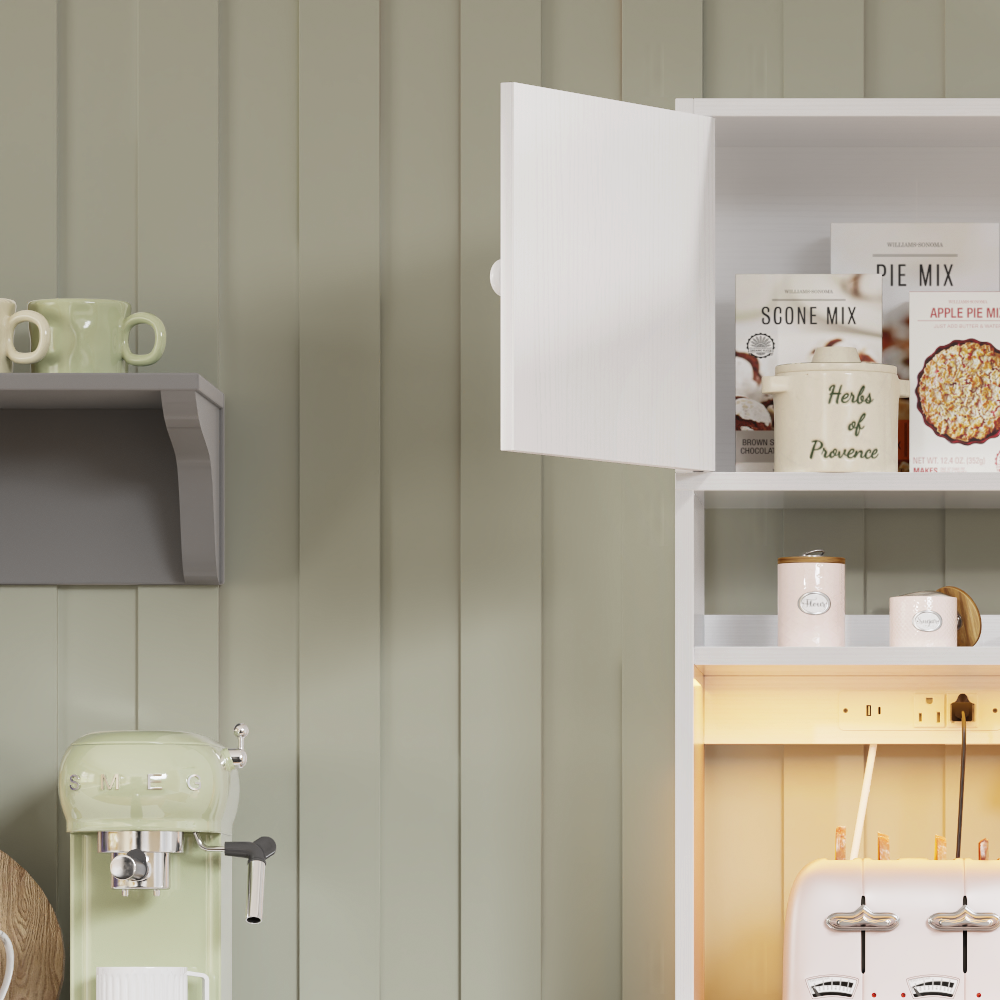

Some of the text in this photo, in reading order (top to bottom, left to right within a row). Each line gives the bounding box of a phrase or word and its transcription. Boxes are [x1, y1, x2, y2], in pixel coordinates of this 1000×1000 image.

[876, 264, 953, 287] PIE MIX
[761, 306, 857, 325] SCONE MIX
[930, 307, 963, 318] APPLE
[967, 307, 983, 318] PIE
[827, 384, 874, 404] Herbs
[847, 412, 867, 437] of
[809, 439, 879, 459] Provence
[69, 773, 202, 791] SMEG
